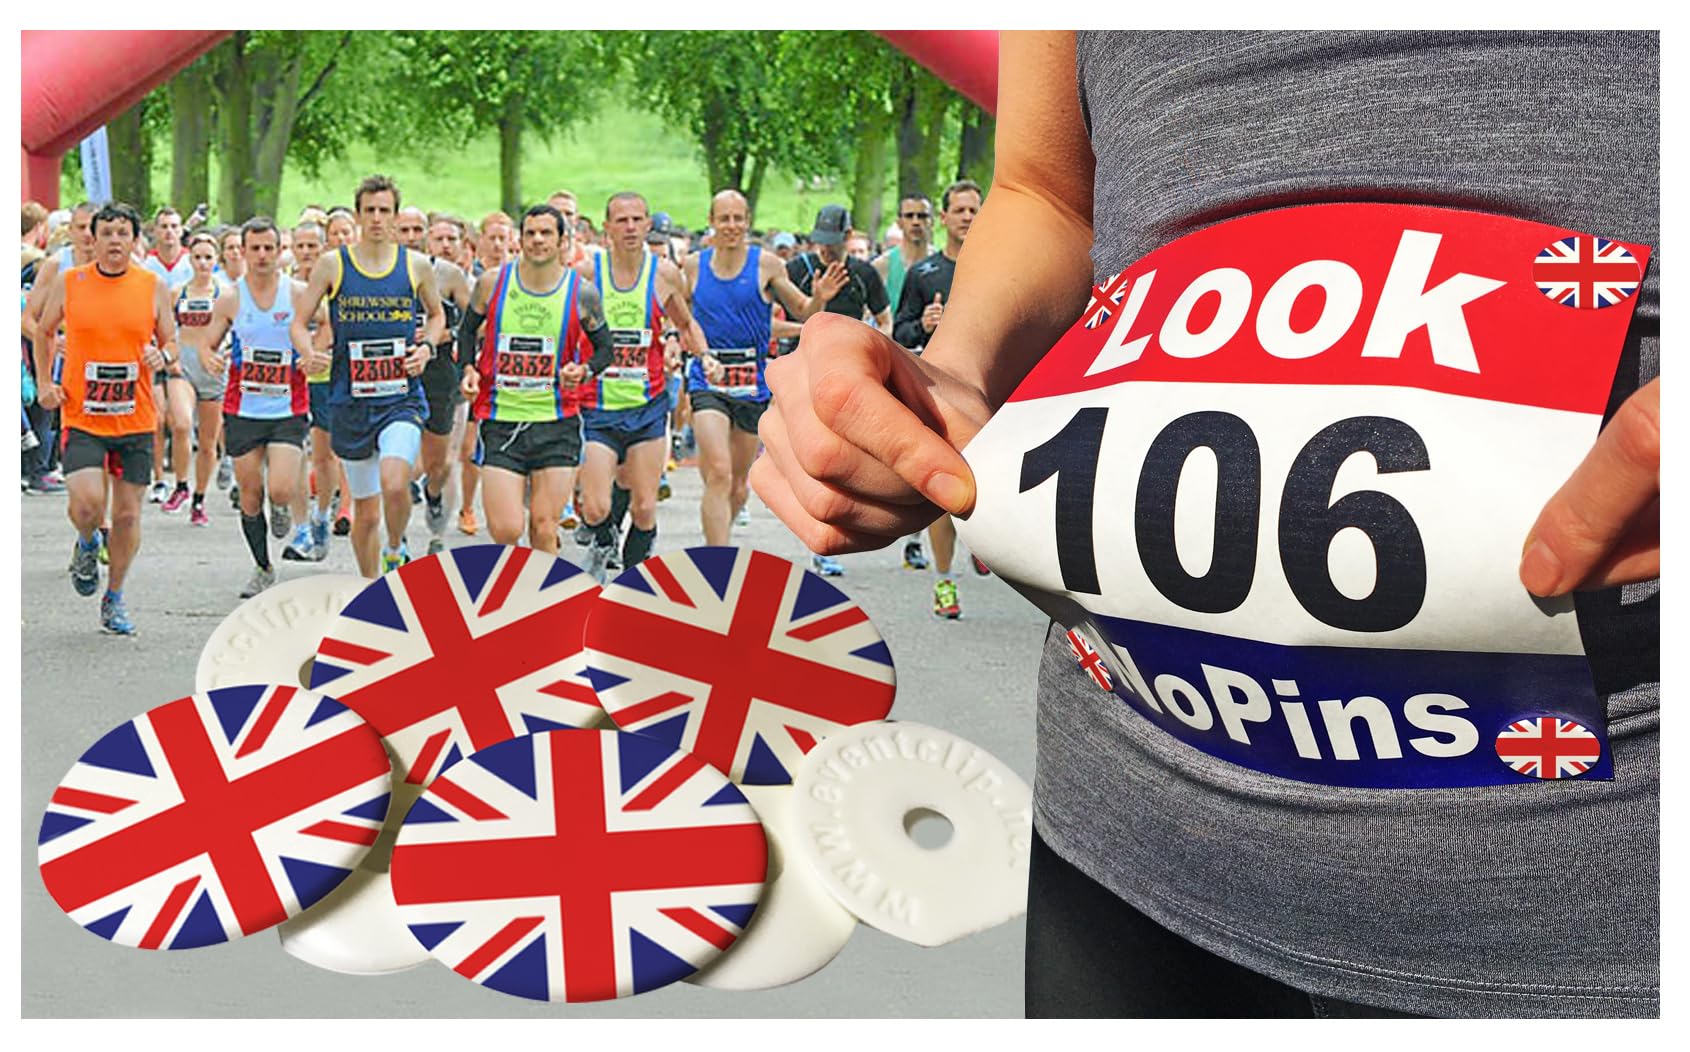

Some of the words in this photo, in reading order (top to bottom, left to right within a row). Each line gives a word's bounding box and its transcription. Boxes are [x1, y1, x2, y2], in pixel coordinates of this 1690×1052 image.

[1084, 229, 1508, 377] Look
[243, 361, 289, 384] 2321
[352, 357, 405, 382] 2308
[499, 352, 552, 377] 2832
[1018, 406, 1432, 633] 106
[1085, 620, 1481, 763] NoPins
